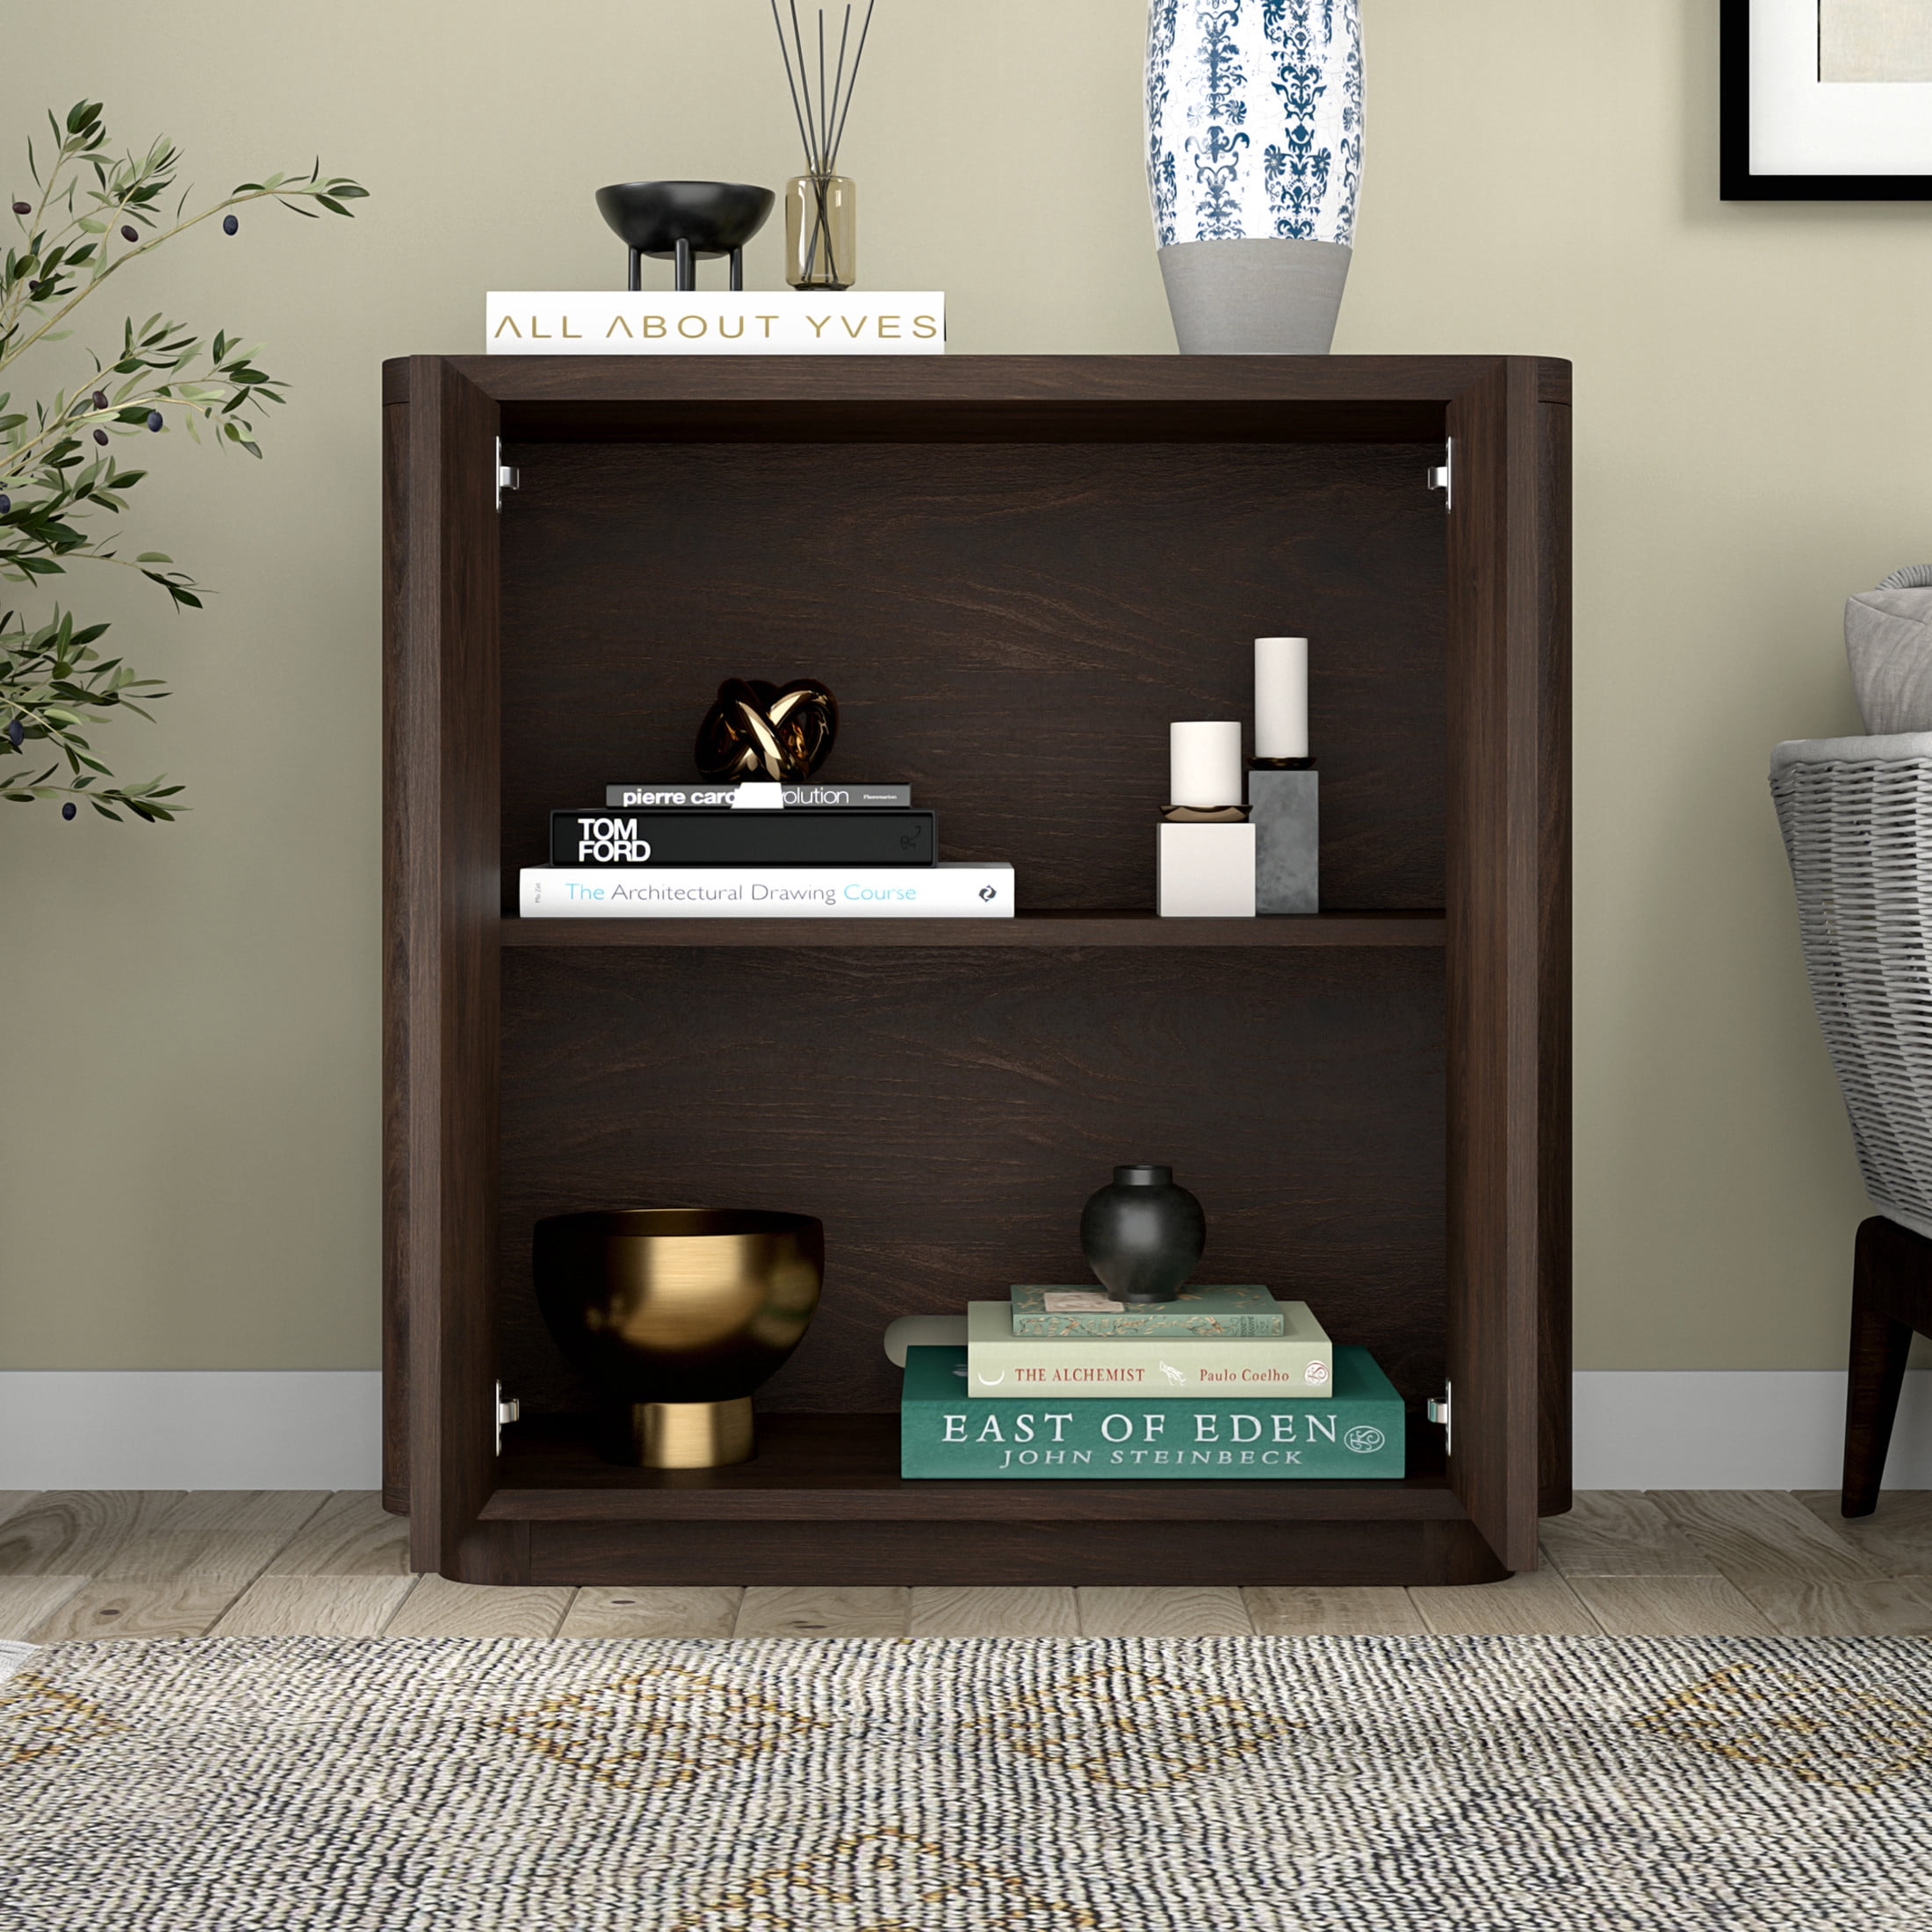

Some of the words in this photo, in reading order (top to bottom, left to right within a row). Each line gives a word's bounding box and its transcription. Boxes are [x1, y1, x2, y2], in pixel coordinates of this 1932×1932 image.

[494, 315, 582, 339] ALL
[606, 314, 780, 339] ABOUT
[805, 314, 937, 339] YVES
[623, 788, 687, 807] pierre
[690, 788, 739, 805] card
[781, 786, 850, 804] olution
[577, 818, 638, 840] TOM
[578, 840, 652, 862] FORD
[565, 883, 605, 901] The
[610, 883, 743, 901] Architectural
[751, 883, 837, 906] Drawing
[843, 883, 917, 901] Course
[1014, 1367, 1047, 1382] THE
[1053, 1367, 1145, 1382] ALCHEMIST
[1200, 1368, 1237, 1382] Paulo
[1241, 1368, 1290, 1382] Coelho
[941, 1413, 1073, 1443] EAST
[1100, 1413, 1166, 1443] OF
[1193, 1413, 1337, 1443] EDEN
[998, 1449, 1092, 1469] JOHN
[1109, 1449, 1303, 1466] STEINBECK
